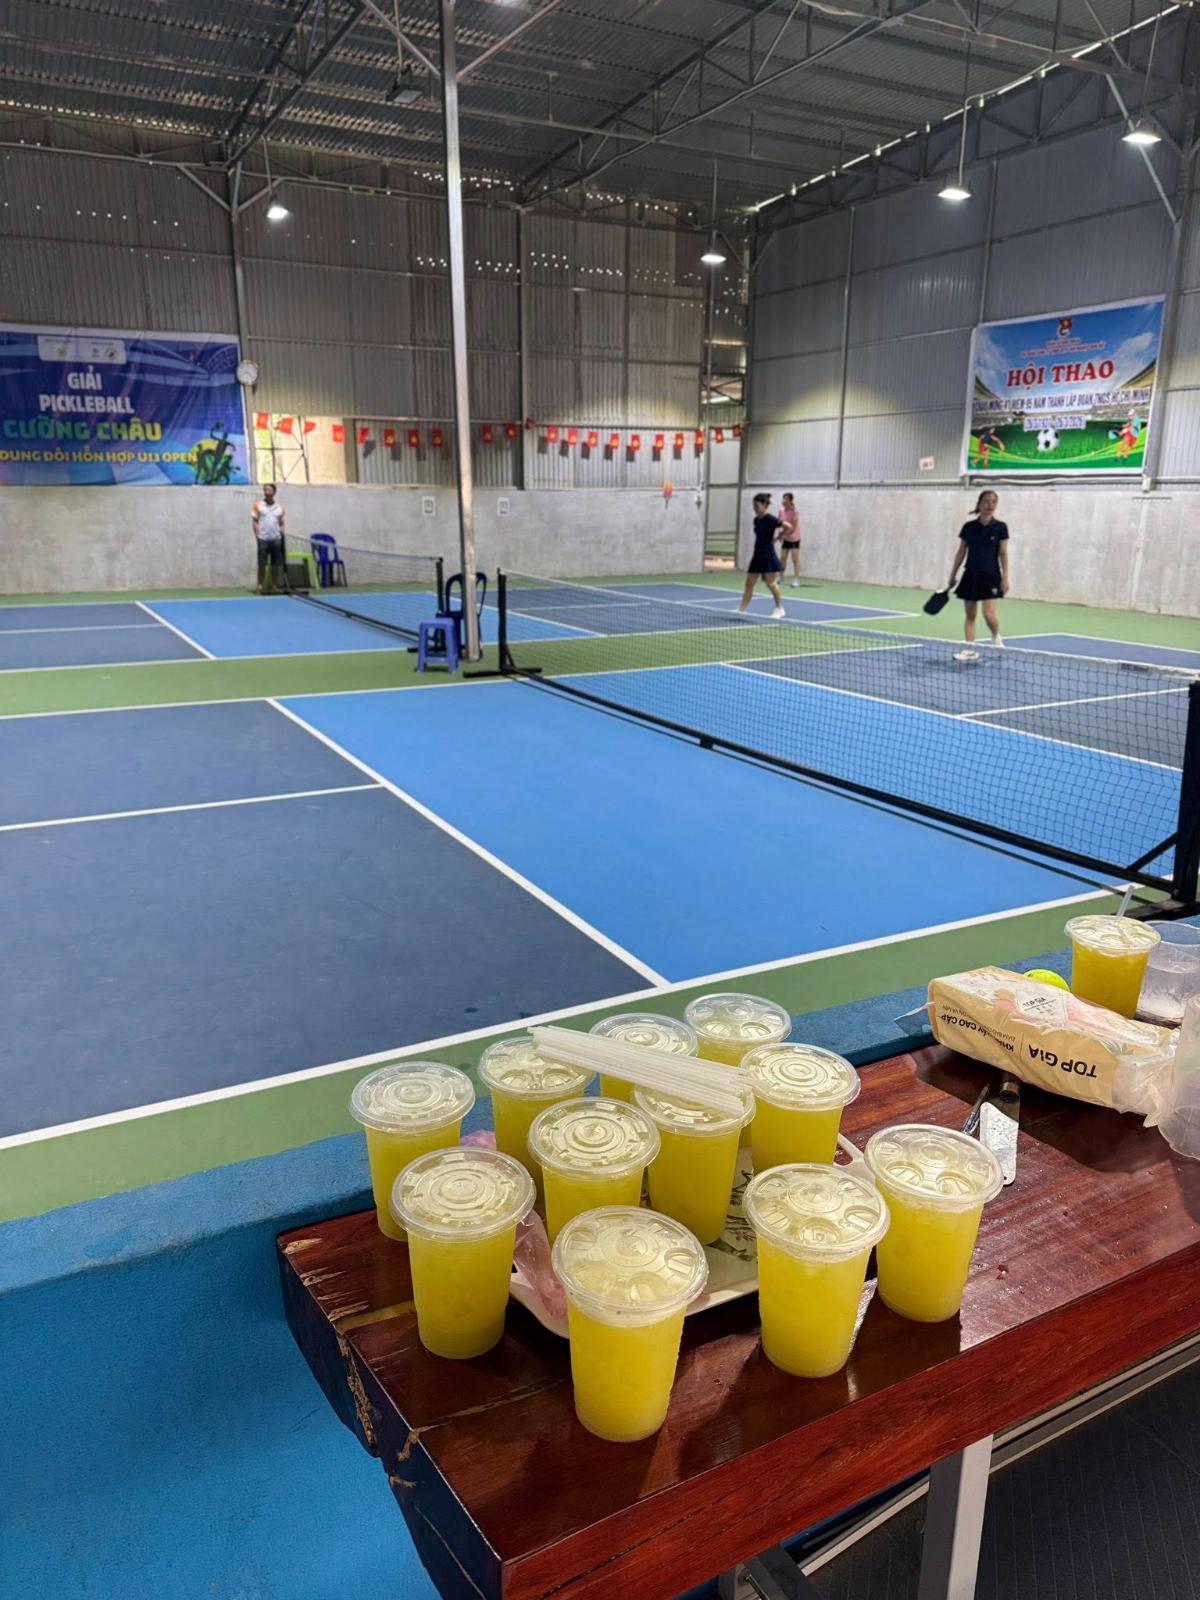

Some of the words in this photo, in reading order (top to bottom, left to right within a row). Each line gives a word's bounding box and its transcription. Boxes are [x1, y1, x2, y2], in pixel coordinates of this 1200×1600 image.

[67, 365, 102, 390] GIẢI
[1007, 363, 1045, 390] HỘI
[1052, 360, 1114, 383] THAO
[38, 394, 135, 414] PICKLEBALL
[97, 417, 162, 441] CHÂU
[0, 449, 41, 461] DUNG
[162, 452, 198, 462] OPEN
[959, 1018, 976, 1030] CAO
[1028, 1044, 1058, 1067] GIA
[1061, 1059, 1097, 1078] TOP
